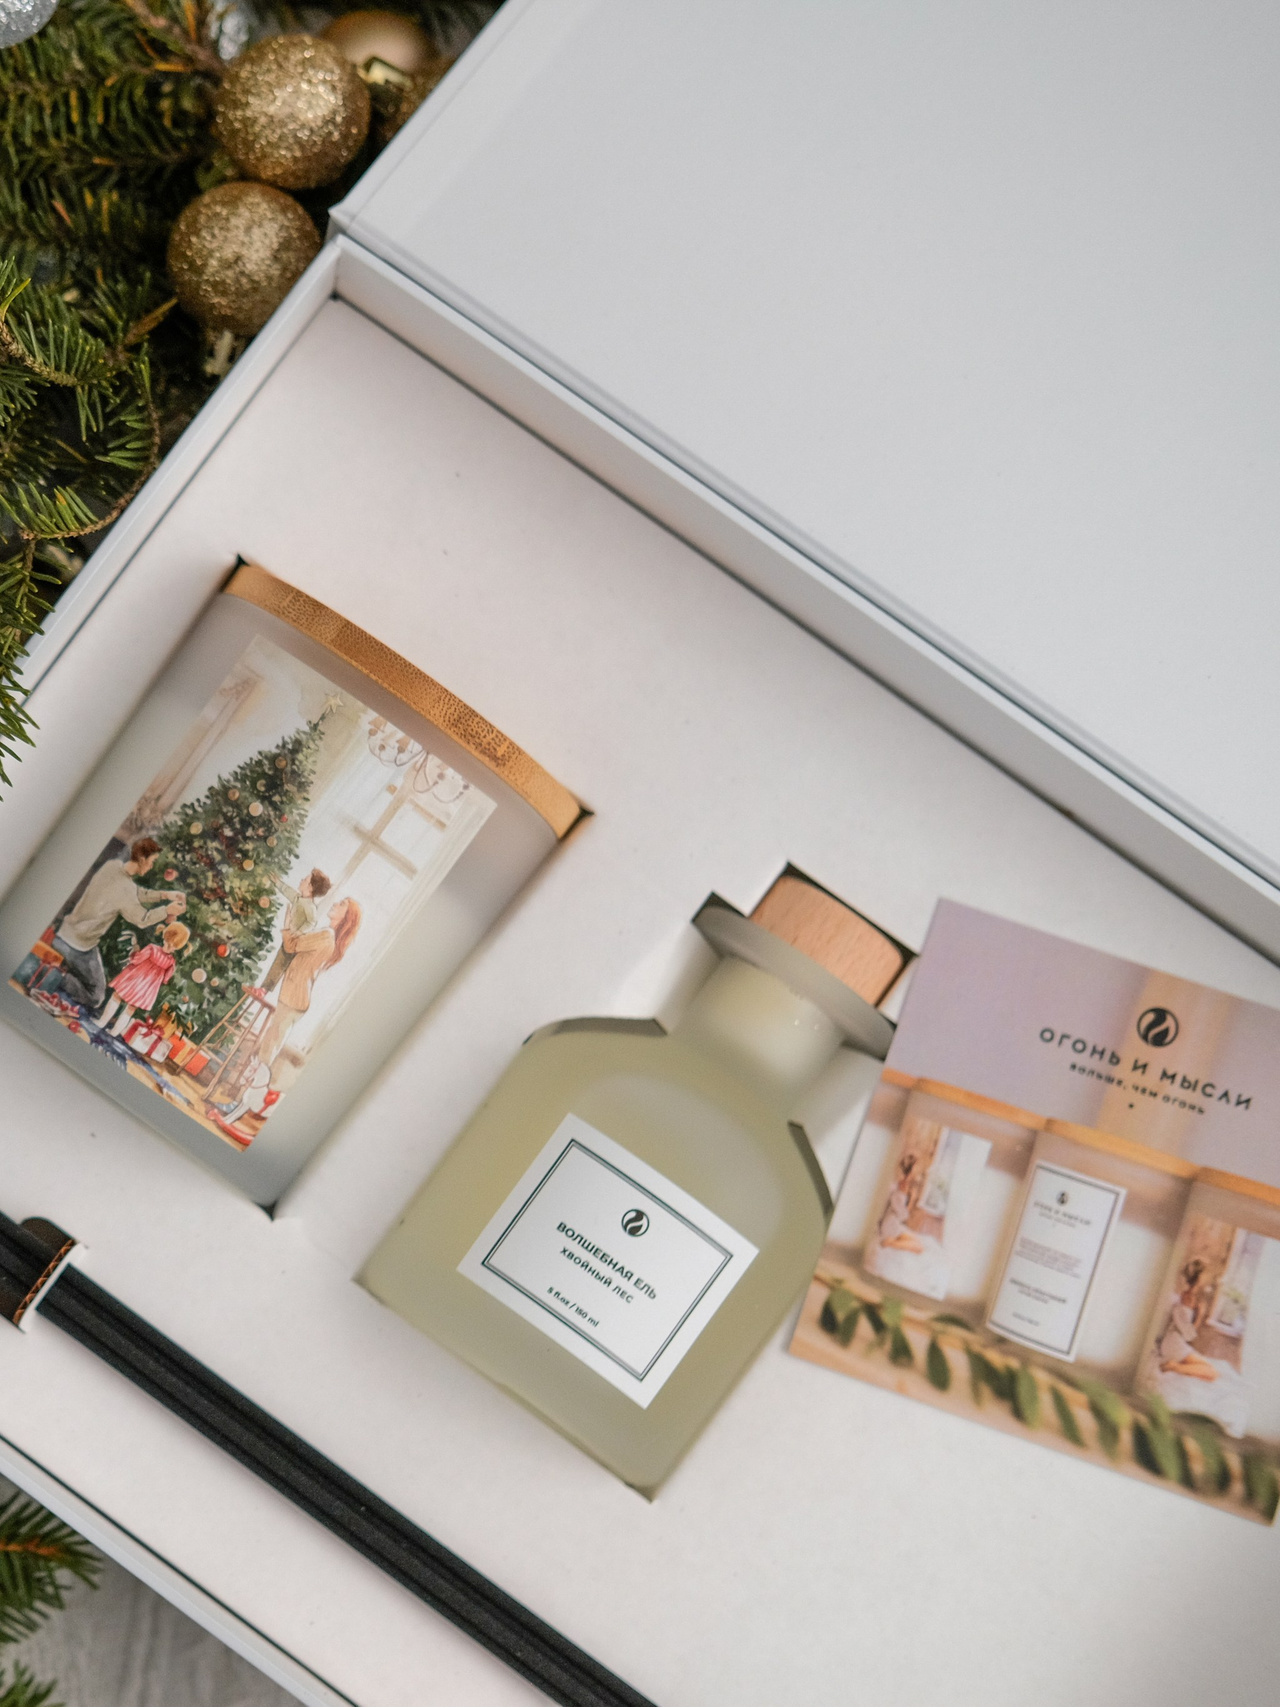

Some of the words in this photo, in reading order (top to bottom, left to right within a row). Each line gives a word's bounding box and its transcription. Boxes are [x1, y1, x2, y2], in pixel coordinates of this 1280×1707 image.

[1039, 1028, 1121, 1067] ОГОНЬ
[1131, 1058, 1150, 1075] И
[1160, 1068, 1253, 1111] МЫСЛИ
[556, 1221, 634, 1282] ВОЛШЕБНАЯ
[633, 1277, 657, 1300] ЕЛЬ
[560, 1245, 613, 1288] ХВОЙНЫЙ
[612, 1285, 634, 1304] ЛЕС
[575, 1306, 589, 1319] 150
[587, 1317, 600, 1328] ml
